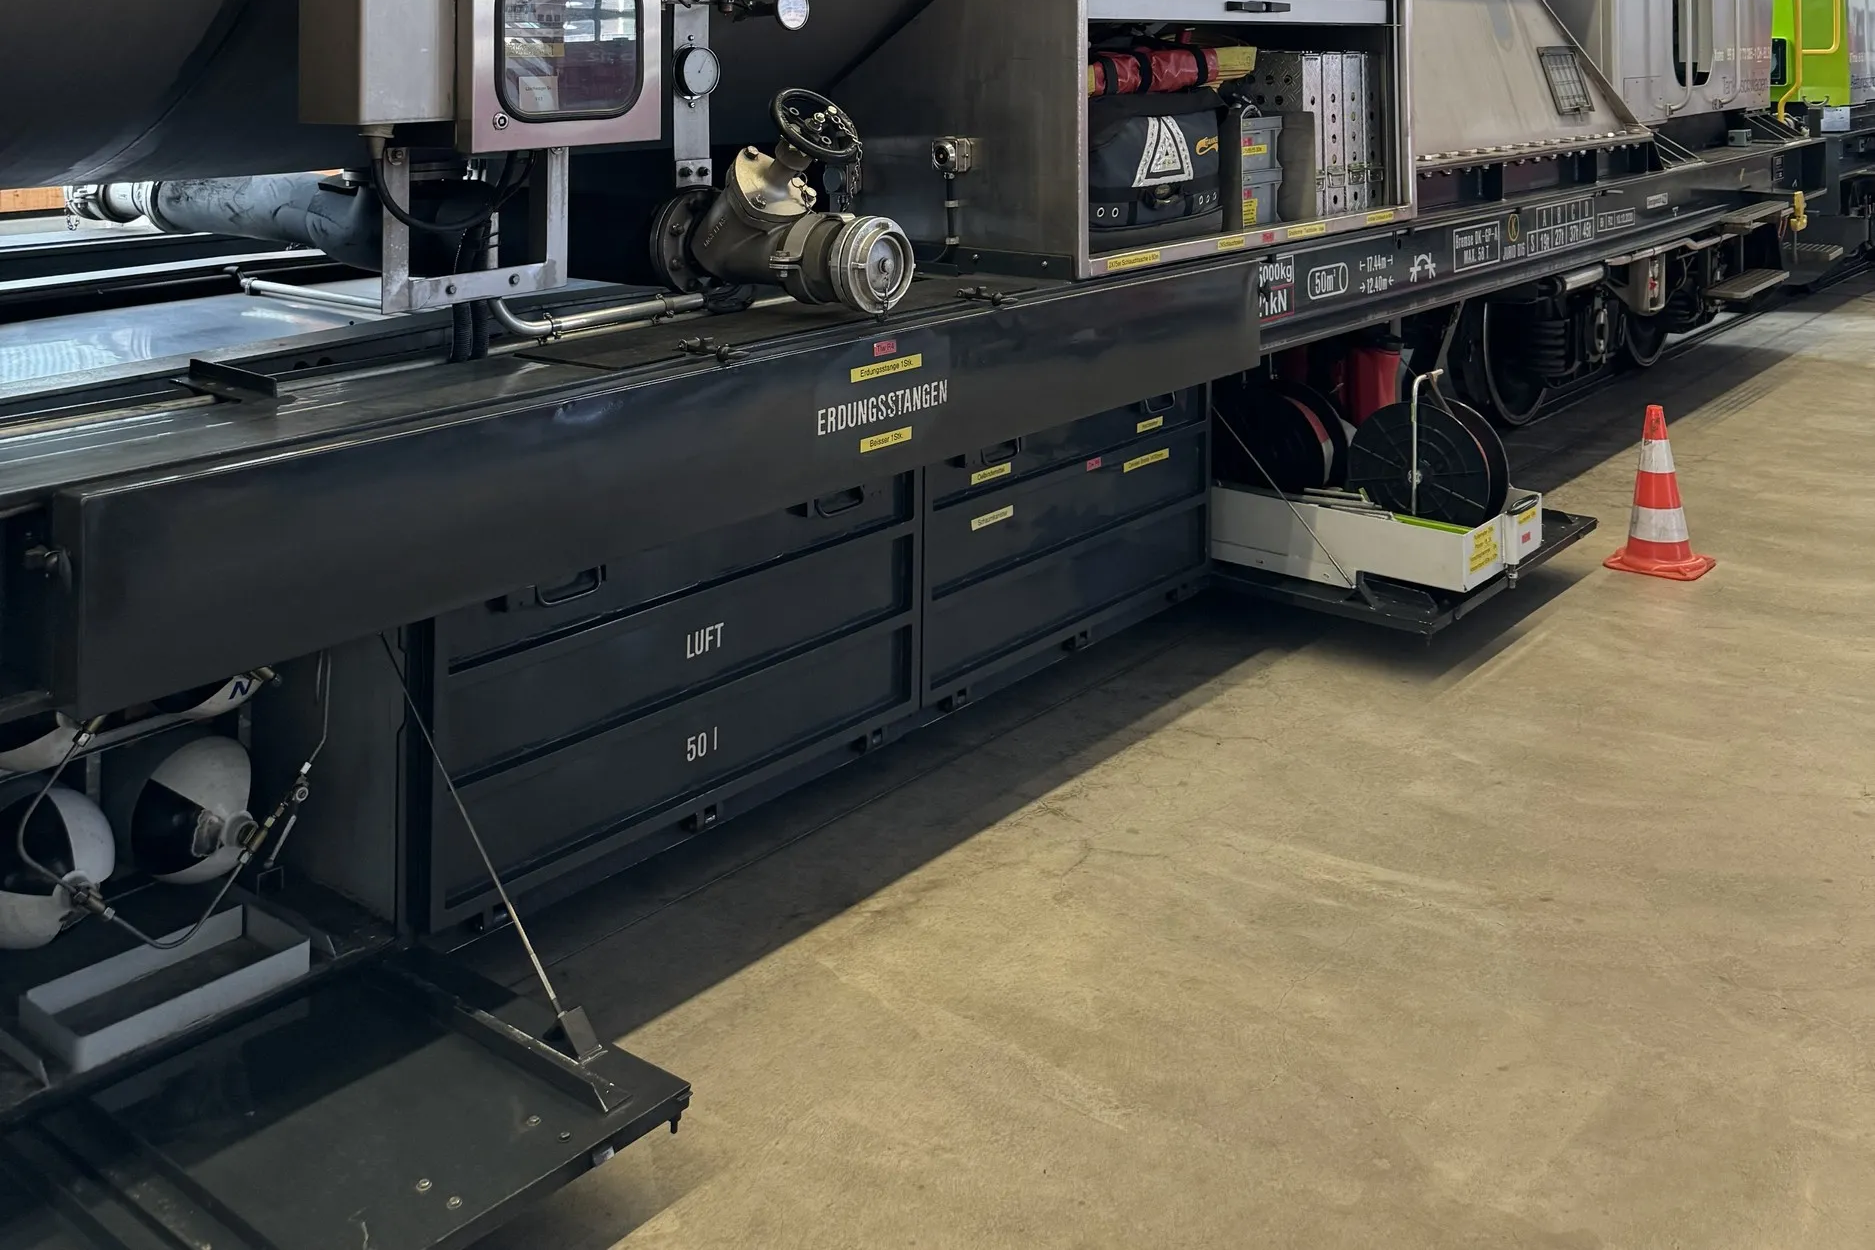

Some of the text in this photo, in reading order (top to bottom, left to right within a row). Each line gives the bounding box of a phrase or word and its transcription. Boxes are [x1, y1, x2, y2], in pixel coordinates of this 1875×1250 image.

[1455, 234, 1474, 250] Bremse
[1530, 234, 1535, 252] S
[1366, 254, 1387, 273] 17.44m
[1366, 275, 1388, 294] 12.40m
[860, 362, 900, 378] Erdungsstange
[817, 379, 948, 436] ERDUNGSSTANGEN
[869, 436, 890, 448] Beisser
[686, 622, 725, 660] LUFT
[686, 732, 707, 762] 50
